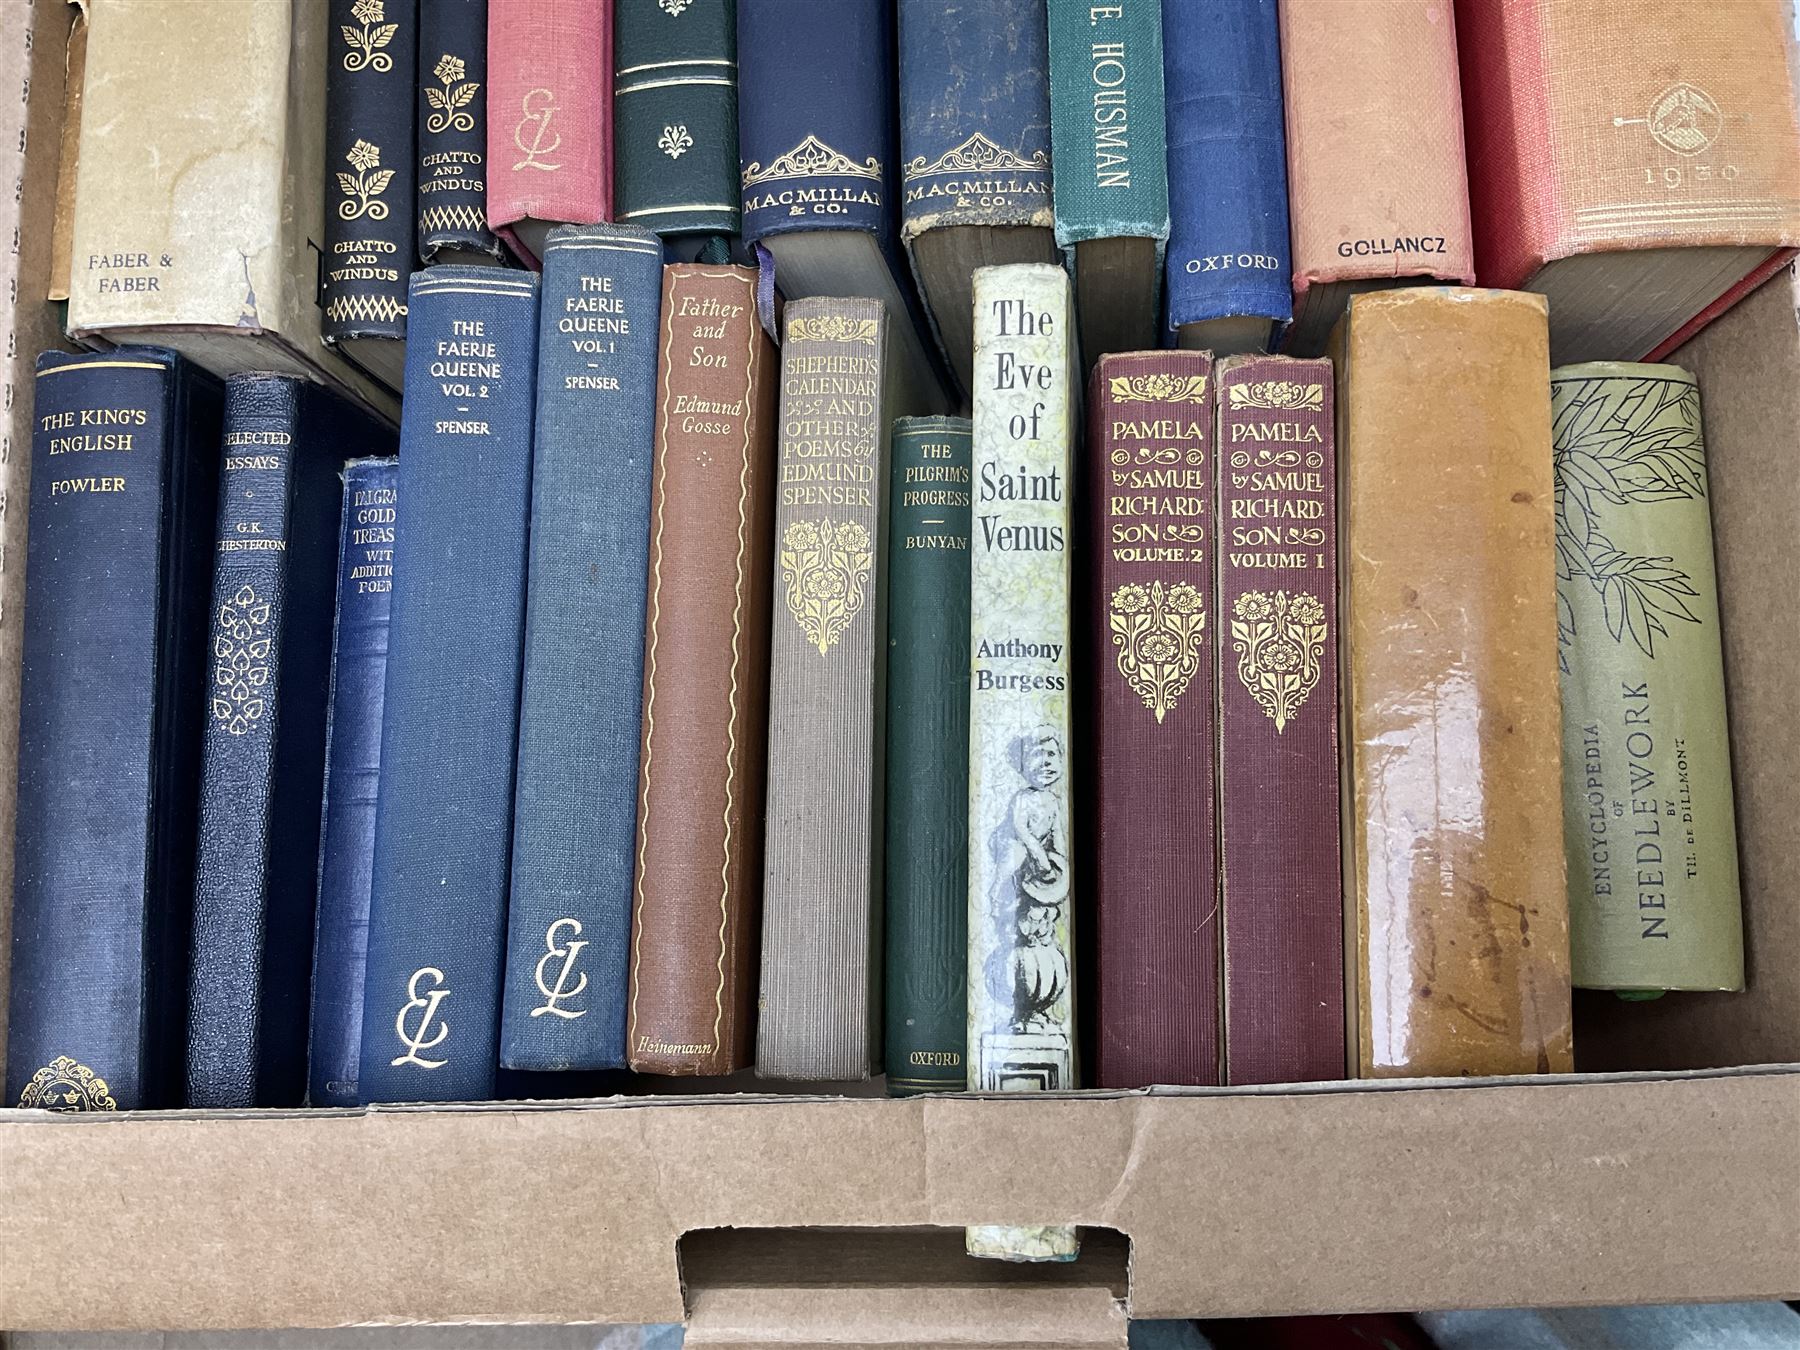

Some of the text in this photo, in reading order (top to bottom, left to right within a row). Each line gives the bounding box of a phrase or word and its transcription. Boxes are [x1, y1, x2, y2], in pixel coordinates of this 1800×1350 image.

[1089, 5, 1130, 189] E. HOUSMAN
[422, 151, 482, 167] CHATTO
[433, 166, 463, 176] AND
[420, 179, 484, 194] WINDUS
[906, 180, 1050, 203] MACMILLAN
[789, 203, 848, 216] & CO.
[956, 196, 1012, 207] & CO.
[334, 240, 397, 254] CHATTO
[1338, 237, 1446, 258] GOLLANCZ
[89, 253, 173, 269] FABER &
[346, 255, 378, 264] AND
[1185, 254, 1279, 274] OXFORD
[99, 276, 160, 292] FABER
[330, 267, 398, 282] WINDUS
[580, 277, 612, 292] THE
[566, 297, 624, 313] FAERIE
[678, 297, 744, 318] Father
[453, 321, 484, 336] THE
[558, 318, 629, 335] QUEENE
[993, 300, 1054, 338] The
[692, 320, 725, 339] and
[437, 341, 496, 357] FAERIE
[571, 341, 608, 353] VOL.
[689, 347, 728, 369] Son
[786, 354, 878, 375] SHEPHERD'S
[430, 363, 501, 379] QUEENE
[993, 352, 1052, 391] Eve
[442, 383, 489, 398] VOL. 2
[564, 376, 620, 391] SPENSER
[786, 377, 876, 397] CALENDAR
[673, 395, 742, 417] Edmund
[826, 398, 873, 417] AND
[41, 409, 147, 431] THE KING'S
[435, 421, 490, 435] SPENSER
[681, 416, 731, 435] Gosse
[786, 420, 859, 437] OTHER
[1008, 402, 1046, 441] of
[1112, 420, 1204, 441] PAMELA
[1231, 422, 1323, 443] PAMELA
[49, 434, 133, 455] ENGLISH
[784, 440, 851, 460] POEMS
[921, 444, 952, 459] THE
[225, 456, 279, 470] ESSAYS
[782, 462, 874, 483] EDMUND
[905, 465, 969, 484] PILGRIM'S
[979, 461, 1062, 503] Saint
[1111, 469, 1204, 490] by SAMUEL
[1232, 472, 1325, 493] by SAMUEL
[51, 477, 126, 496] FOWLER
[783, 486, 872, 507] SPENSER
[903, 489, 969, 507] PROGRESS
[905, 535, 968, 550] BUNYAN
[977, 515, 1064, 552] Venus
[1112, 524, 1160, 544] SON
[1232, 526, 1282, 547] SON
[1230, 552, 1307, 569] VOLUME
[977, 638, 1063, 662] Anthony
[976, 669, 1065, 693] Burgess
[1584, 724, 1612, 896] ENCYCLOPEDIA
[1613, 800, 1624, 817] OF
[1622, 681, 1669, 939] NEEDLEWORK
[1665, 801, 1676, 816] BY
[1686, 830, 1695, 844] DE
[636, 1035, 712, 1054] Heinemann
[910, 1051, 960, 1067] OXFORD
